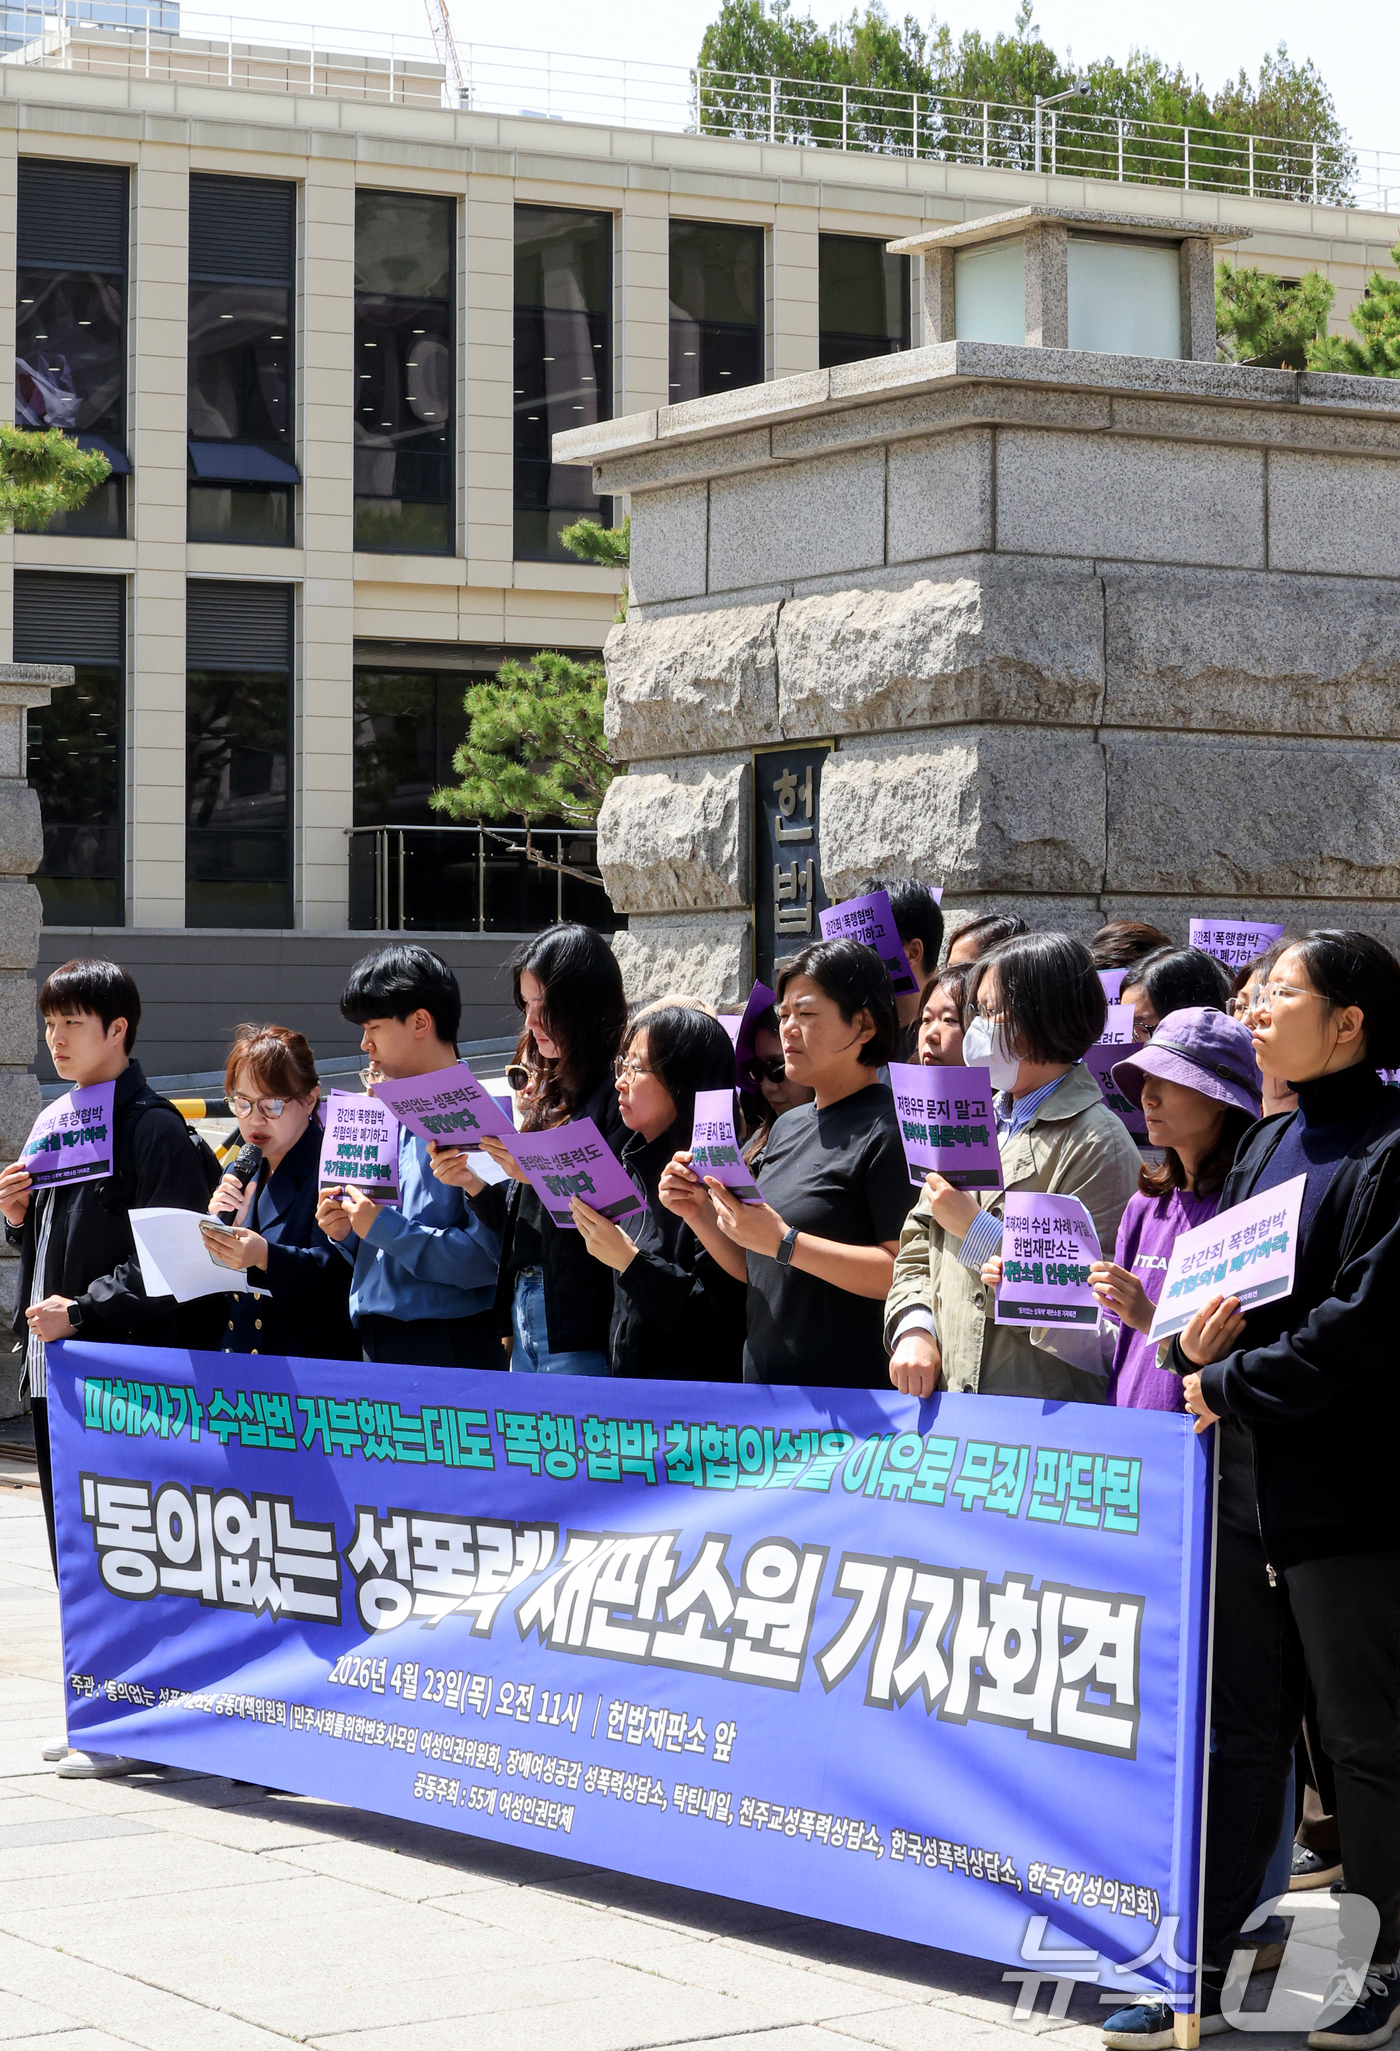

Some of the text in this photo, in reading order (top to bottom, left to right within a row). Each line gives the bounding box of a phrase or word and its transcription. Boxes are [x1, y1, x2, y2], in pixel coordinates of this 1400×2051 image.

[773, 766, 813, 969] 헌법
[825, 917, 843, 936] 강간죄
[1193, 929, 1260, 948] 강간죄 '폭행협박
[391, 1085, 481, 1115] 동의없는 성폭력도
[897, 1095, 988, 1120] 저항유무 묻지 말고
[57, 1104, 104, 1128] 폭행협박
[337, 1108, 385, 1125] 강간죄 '폭행협박
[418, 1108, 480, 1134] 강간이다
[62, 1124, 108, 1148] 폐기하라
[332, 1125, 389, 1143] 최협의설' 폐기하고
[718, 1121, 733, 1141] 말고
[928, 1124, 990, 1148] 질문하라
[336, 1142, 379, 1162] 피해자의 성적
[517, 1154, 554, 1171] 동의없는
[552, 1143, 604, 1171] 성폭력도
[359, 1162, 392, 1181] 보장하라
[1031, 1219, 1050, 1235] 수십
[1053, 1217, 1072, 1236] 차례
[1013, 1236, 1080, 1260] 헌법재판소는
[1180, 1208, 1287, 1274] 강간죄 폭행협박
[1004, 1260, 1044, 1284] 재판소원
[1133, 1253, 1171, 1271] ITICA
[1167, 1230, 1289, 1299] 최협의설 폐기하라
[83, 1376, 204, 1440] 피해자가
[207, 1389, 297, 1452] 수십번
[296, 1395, 495, 1471] 거부했는데도
[841, 1430, 960, 1507] 이유로
[951, 1437, 1030, 1518] 무죄
[1029, 1447, 1142, 1535] 판단된
[78, 1472, 1145, 1759] '동의없는 성폭력' 재판소원 기자회견
[327, 1653, 387, 1695] 2026년
[390, 1661, 420, 1701] 4월
[422, 1668, 493, 1719] 23일(목)
[495, 1682, 536, 1723] 오전
[537, 1689, 584, 1733] 11시
[607, 1699, 708, 1754] 헌법재판소
[712, 1720, 739, 1764] 앞
[70, 1673, 96, 1699] 주관
[215, 1691, 287, 1728] 공동대책위원회
[289, 1702, 419, 1755] (민주사회를위한변호사모임
[419, 1730, 503, 1777] 여성인권위원회,
[505, 1748, 583, 1791] 장애여성공감
[583, 1764, 668, 1813] 성폭력상담소,
[672, 1782, 734, 1828] 탁틴내일,
[738, 1796, 886, 1861] 천주교성폭력상담소,
[889, 1827, 1024, 1894] 한국성폭력상담소,
[1027, 1860, 1161, 1928] 한국여성의전화)
[412, 1771, 461, 1809] 공동주최
[467, 1785, 498, 1816] 55개
[498, 1790, 576, 1835] 여성인권단체
